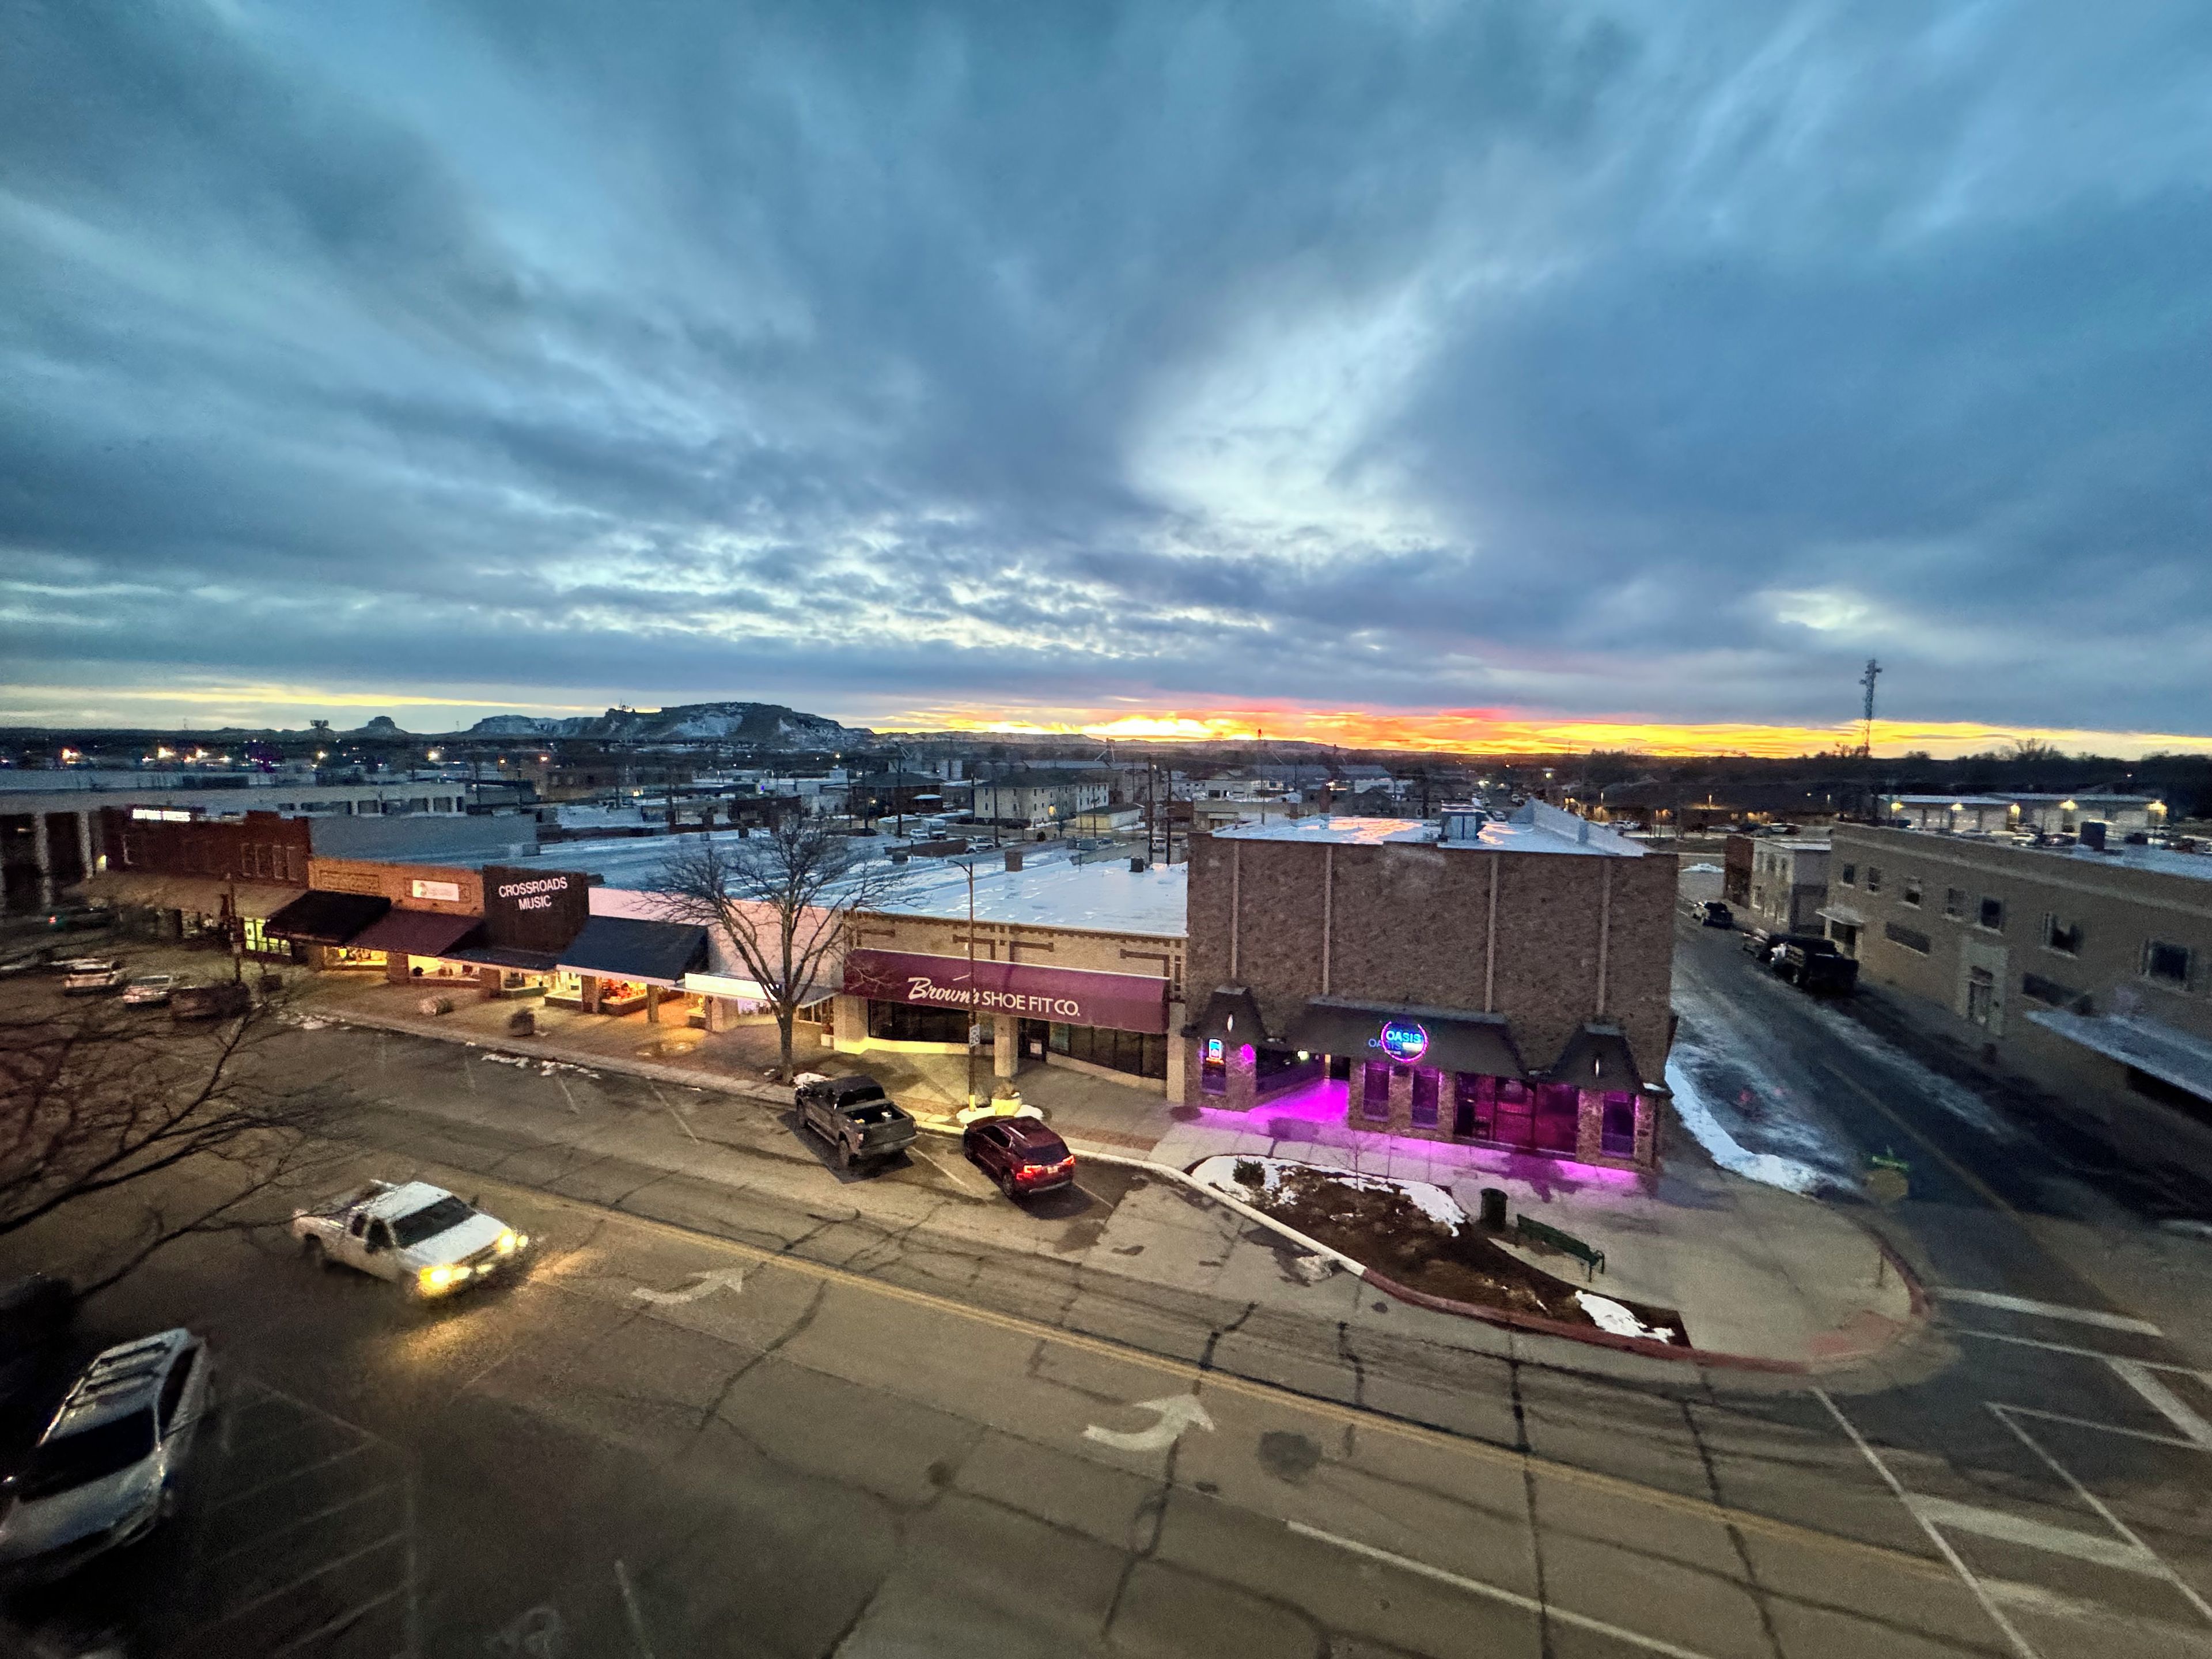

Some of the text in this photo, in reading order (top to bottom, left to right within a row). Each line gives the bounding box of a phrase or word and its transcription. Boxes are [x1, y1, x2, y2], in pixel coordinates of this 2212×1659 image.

[498, 876, 567, 897] CROSSROADS
[518, 895, 552, 910] MUSIC
[907, 976, 1081, 1017] Brown's SHOE FIT CO.
[1385, 1030, 1422, 1044] OASIS
